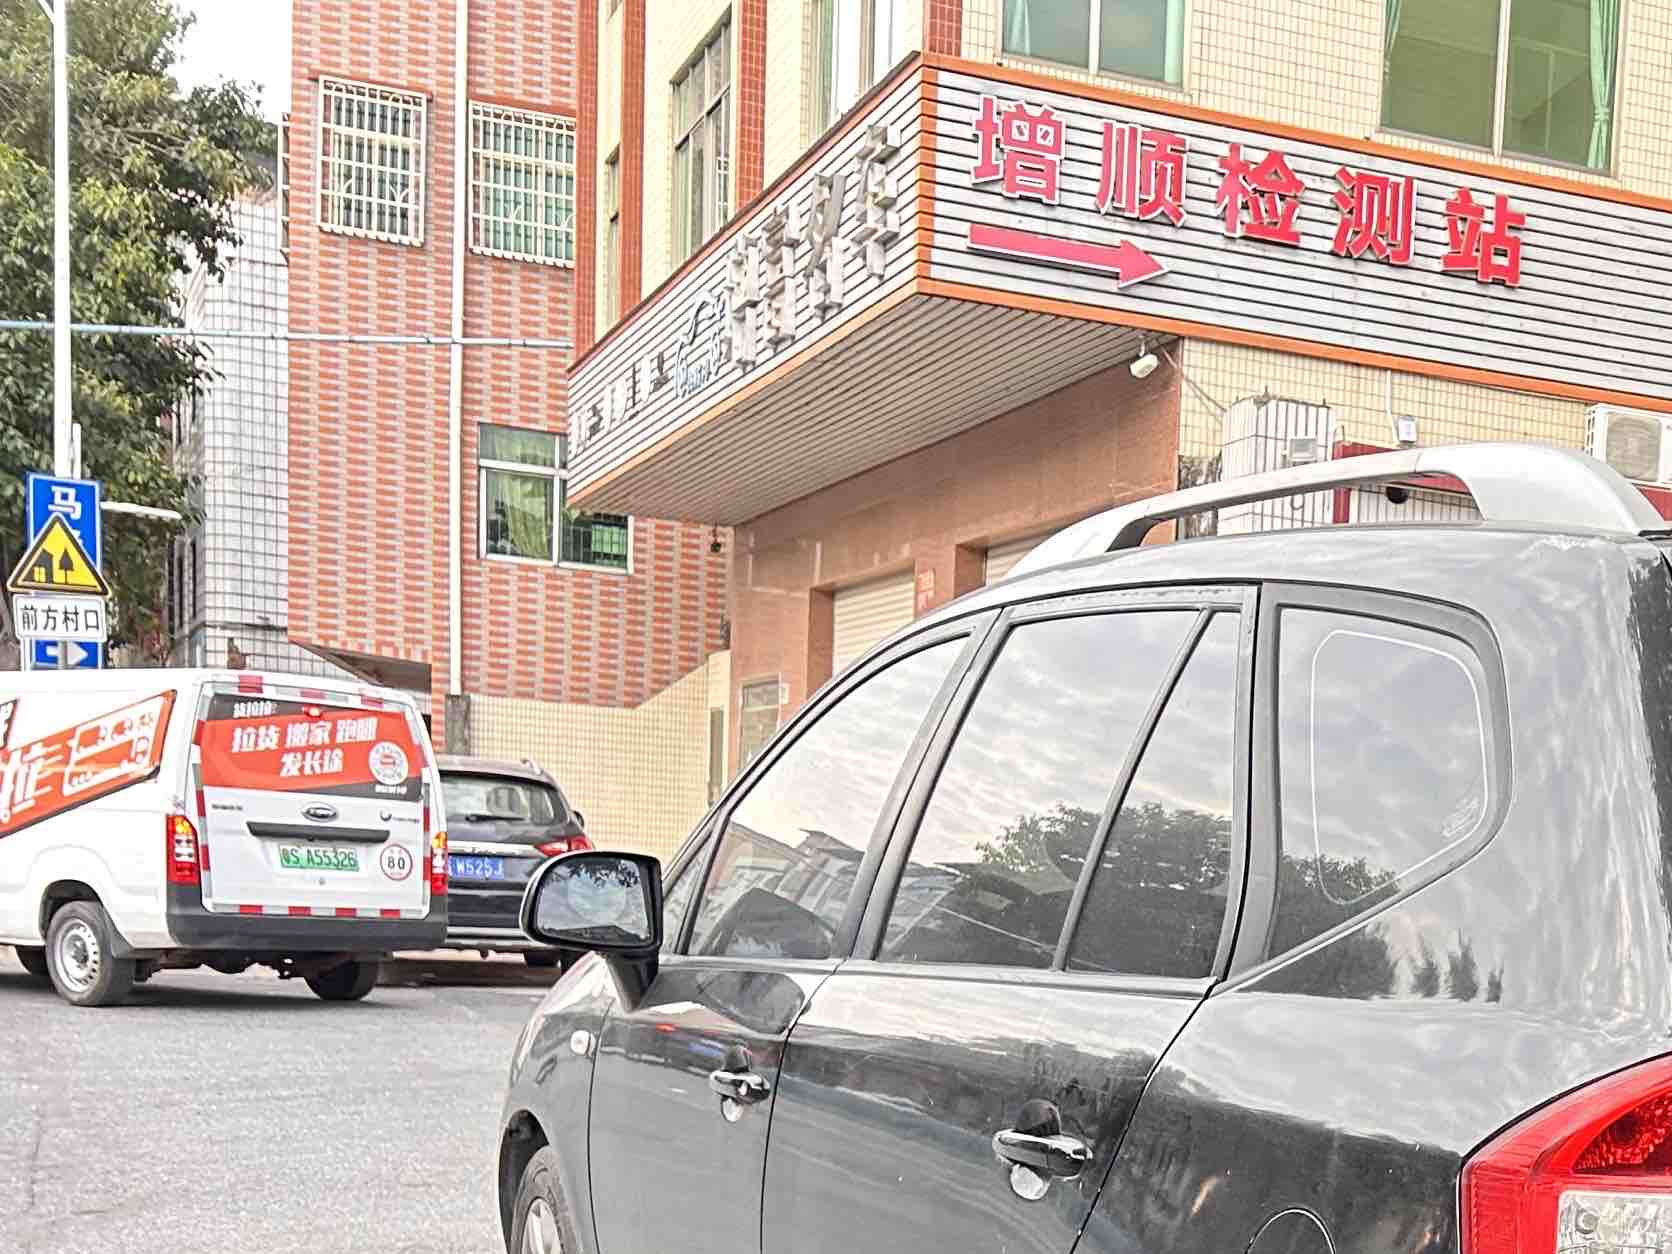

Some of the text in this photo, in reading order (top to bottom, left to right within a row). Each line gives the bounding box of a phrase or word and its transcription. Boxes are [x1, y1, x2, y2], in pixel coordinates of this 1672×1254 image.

[970, 96, 1527, 288] 增顺检测站
[20, 604, 100, 632] 前方村口
[388, 856, 405, 870] 80
